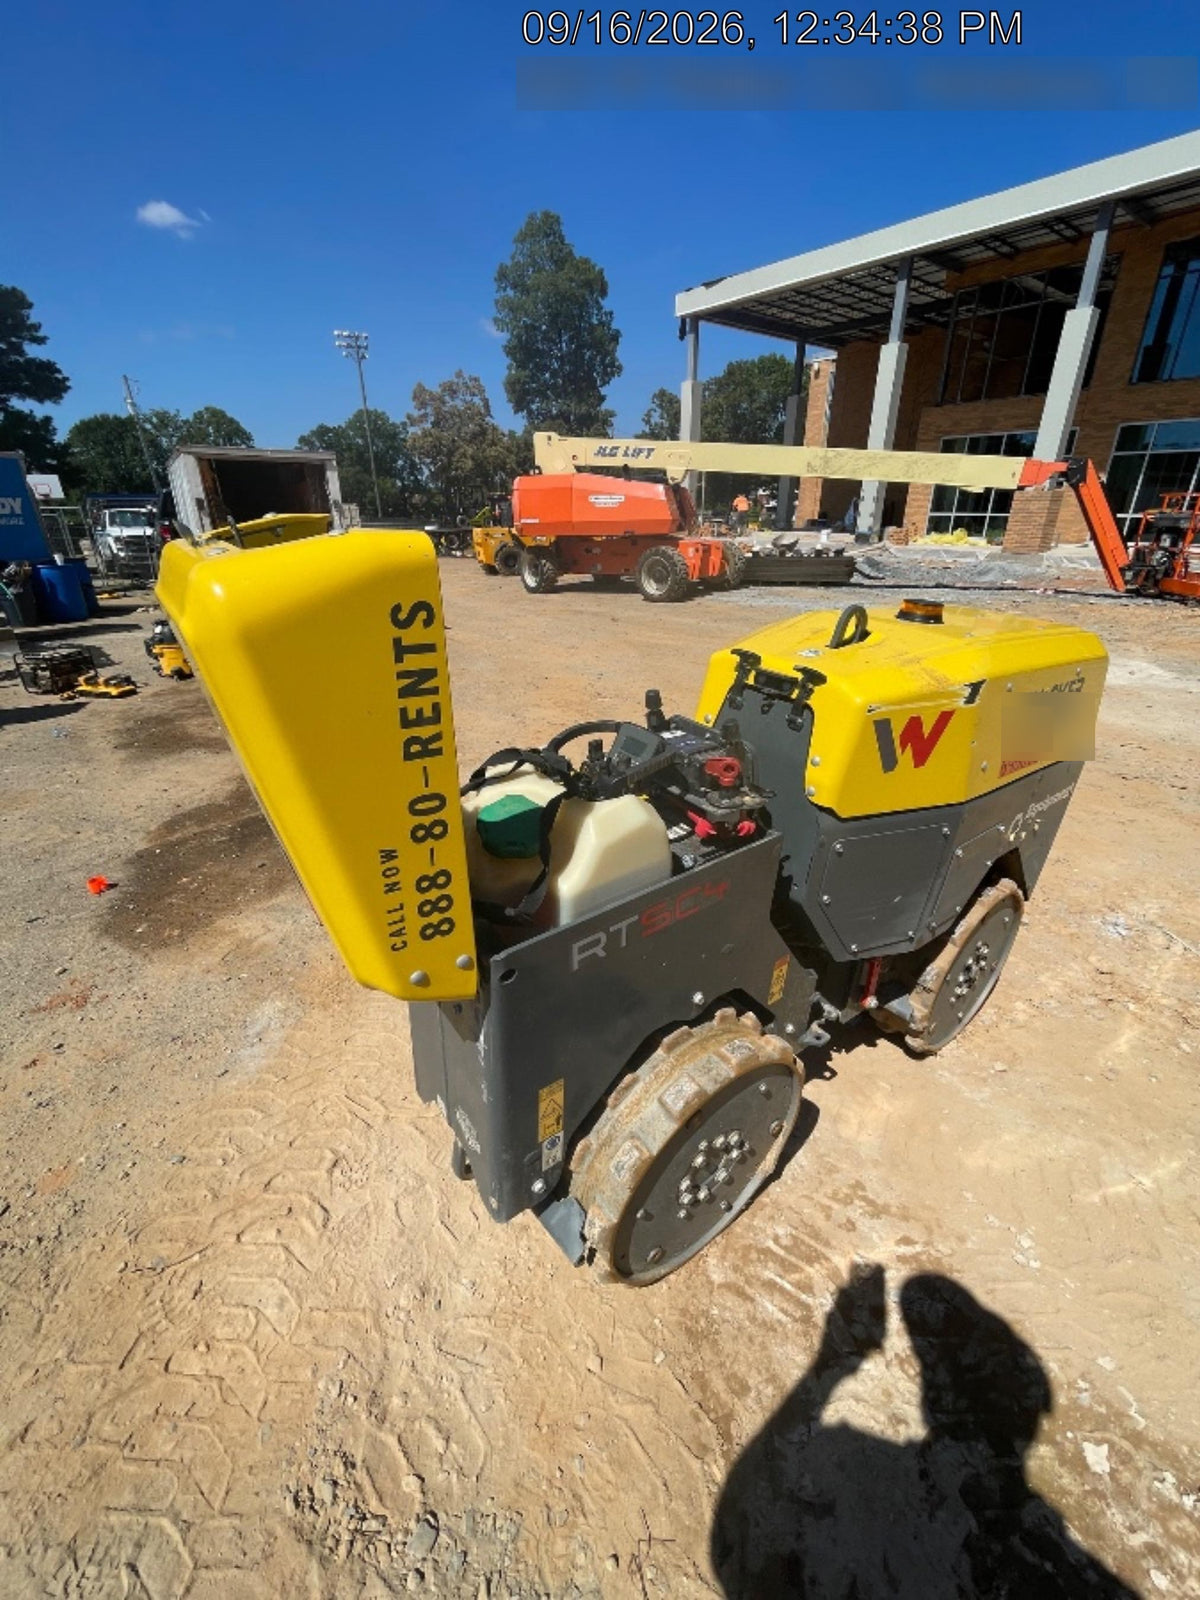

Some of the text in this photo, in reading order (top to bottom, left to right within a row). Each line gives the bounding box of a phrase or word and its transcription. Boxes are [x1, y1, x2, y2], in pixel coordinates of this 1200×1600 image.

[593, 446, 656, 459] JLG LIFT
[389, 600, 456, 942] 888-80-RENTS
[378, 848, 408, 952] CALL NOW
